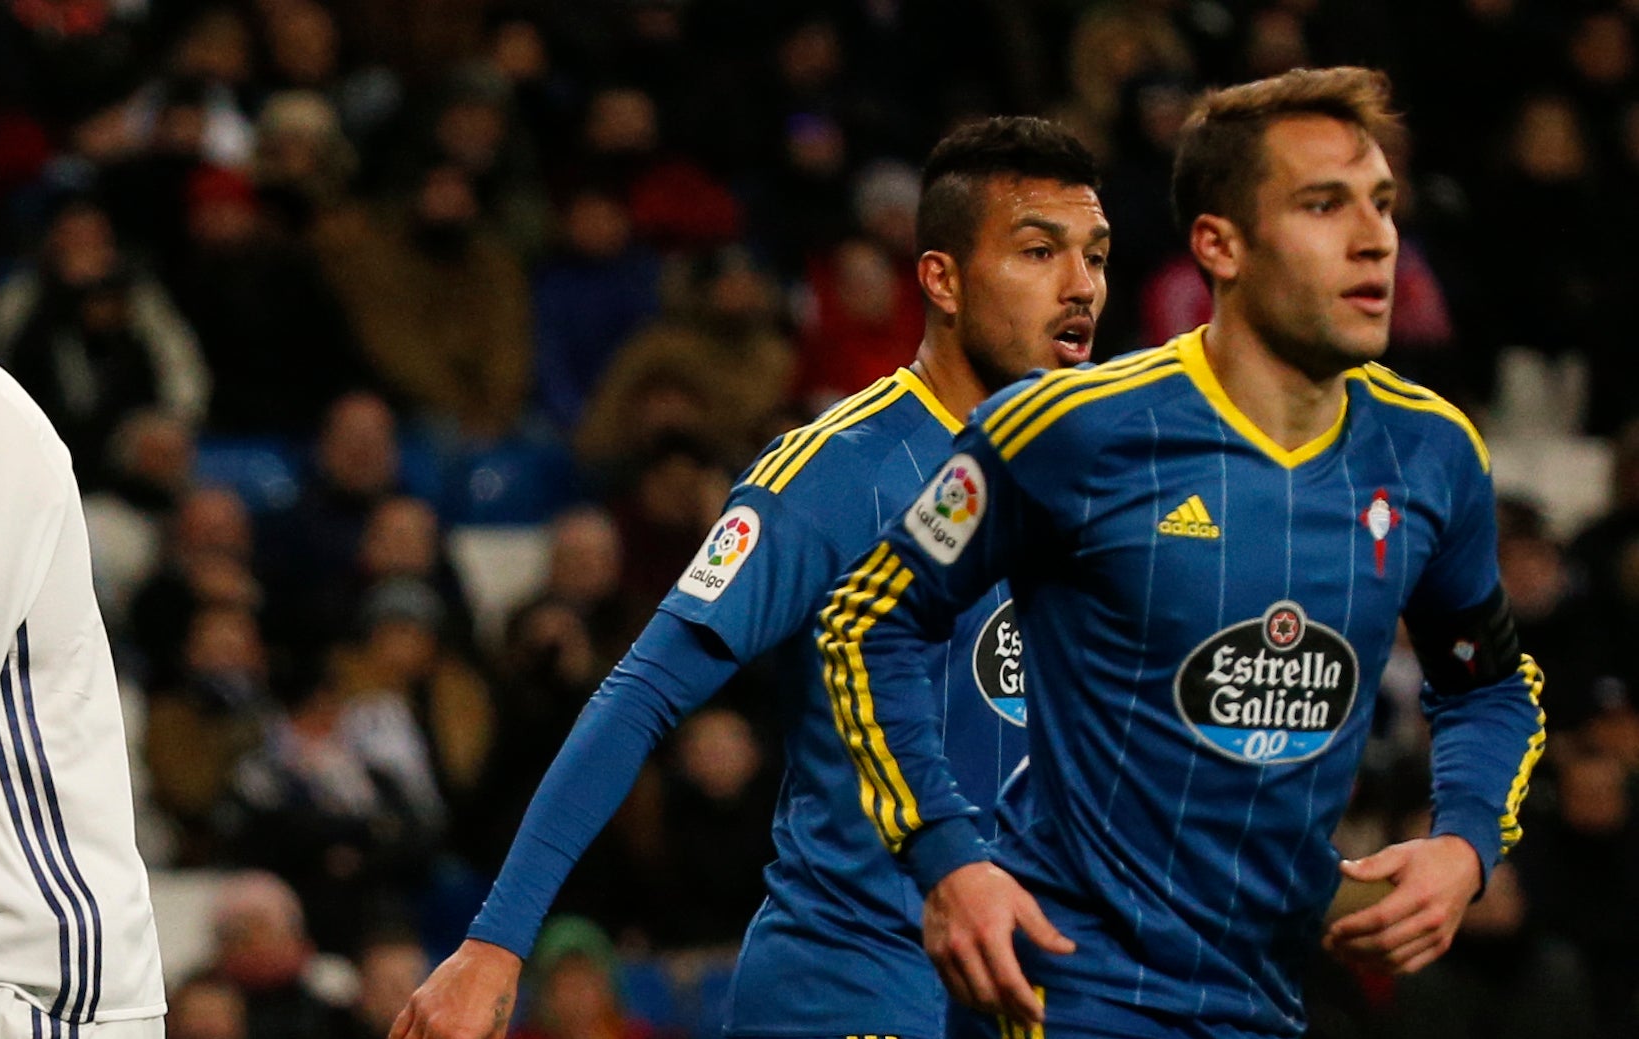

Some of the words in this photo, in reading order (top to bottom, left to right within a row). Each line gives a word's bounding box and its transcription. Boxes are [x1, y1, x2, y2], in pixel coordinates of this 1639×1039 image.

[1158, 520, 1220, 539] adidas
[689, 565, 725, 588] LaLiga
[1205, 644, 1343, 690] Estrella
[1210, 684, 1331, 729] Galicia
